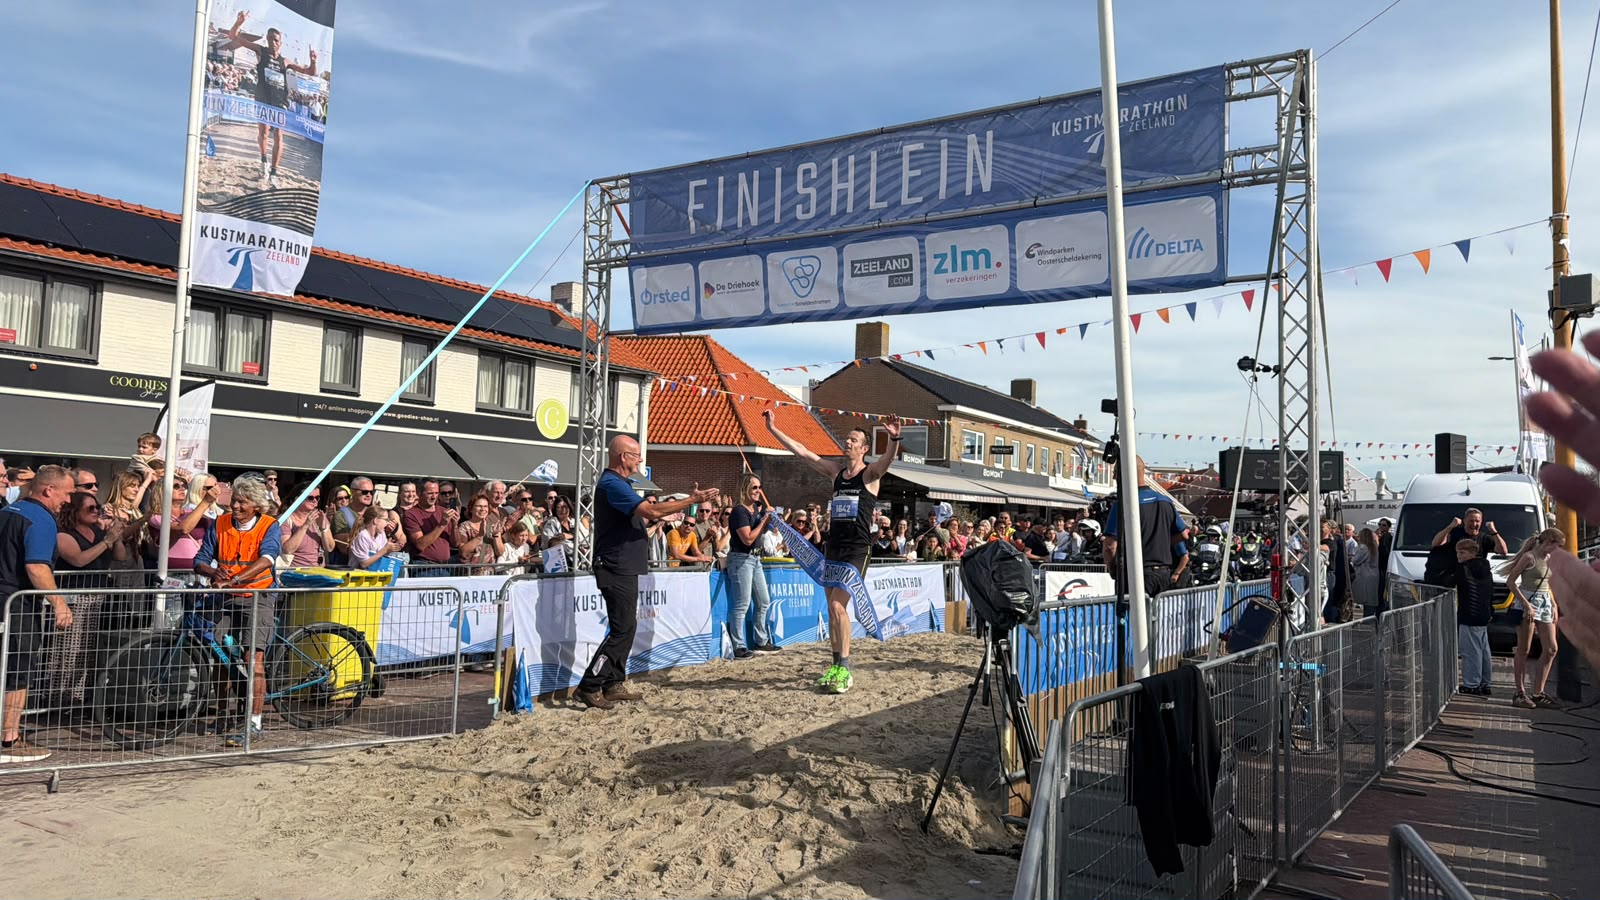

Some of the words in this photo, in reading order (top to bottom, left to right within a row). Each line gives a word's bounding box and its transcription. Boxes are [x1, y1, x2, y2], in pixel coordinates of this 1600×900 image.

[1051, 93, 1188, 137] KUSTMRATHON
[1129, 114, 1176, 132] ZEELAND
[687, 130, 993, 235] FINISHLEIN
[200, 225, 309, 258] KUSTMARATHON
[1155, 238, 1204, 257] DELTA
[266, 250, 300, 266] ZEELAND
[1037, 246, 1075, 256] Windparken
[1037, 252, 1102, 266] Oosterscheldekering
[853, 257, 910, 275] ZEELAND
[716, 283, 726, 291] De
[727, 279, 760, 290] Driehoek
[945, 272, 998, 284] verzekeringen
[641, 286, 690, 305] Ørsted
[109, 375, 168, 392] GOODIES
[347, 407, 374, 416] shopping
